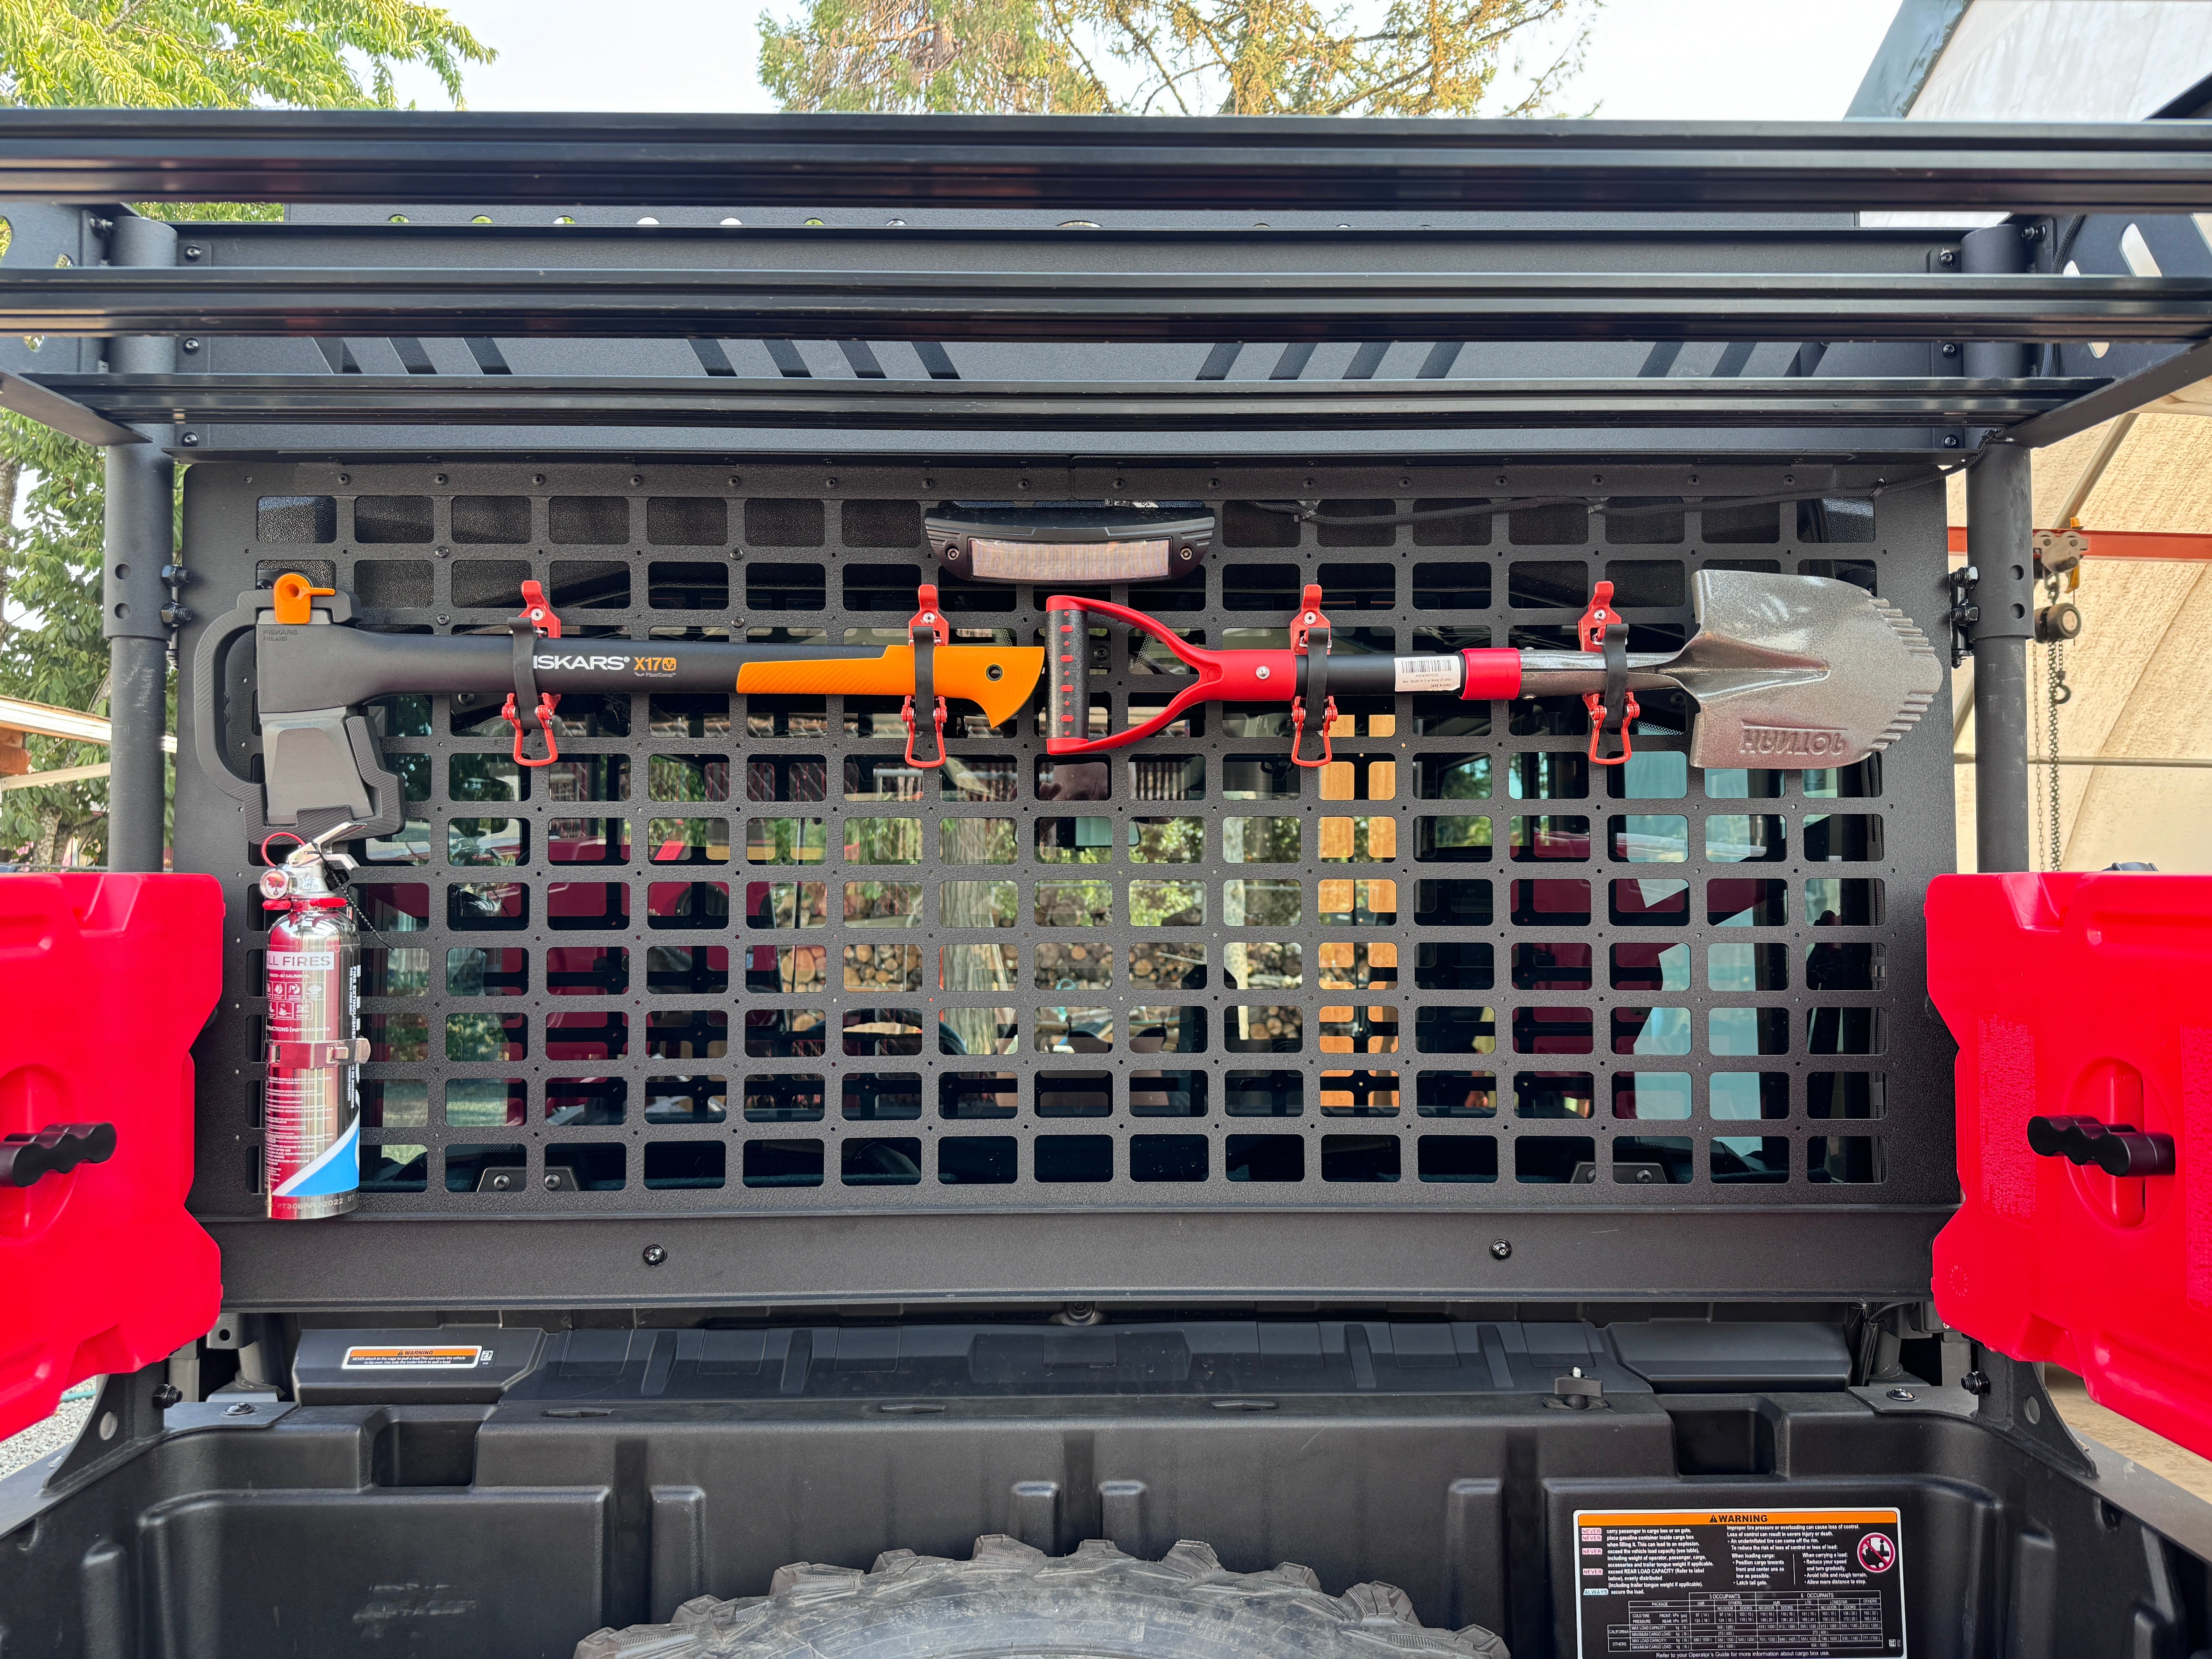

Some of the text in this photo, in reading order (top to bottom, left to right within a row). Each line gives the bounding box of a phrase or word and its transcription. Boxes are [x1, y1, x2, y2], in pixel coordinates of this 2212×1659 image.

[634, 657, 661, 670] X17
[283, 956, 330, 966] FIRES
[322, 1198, 343, 1207] 2022
